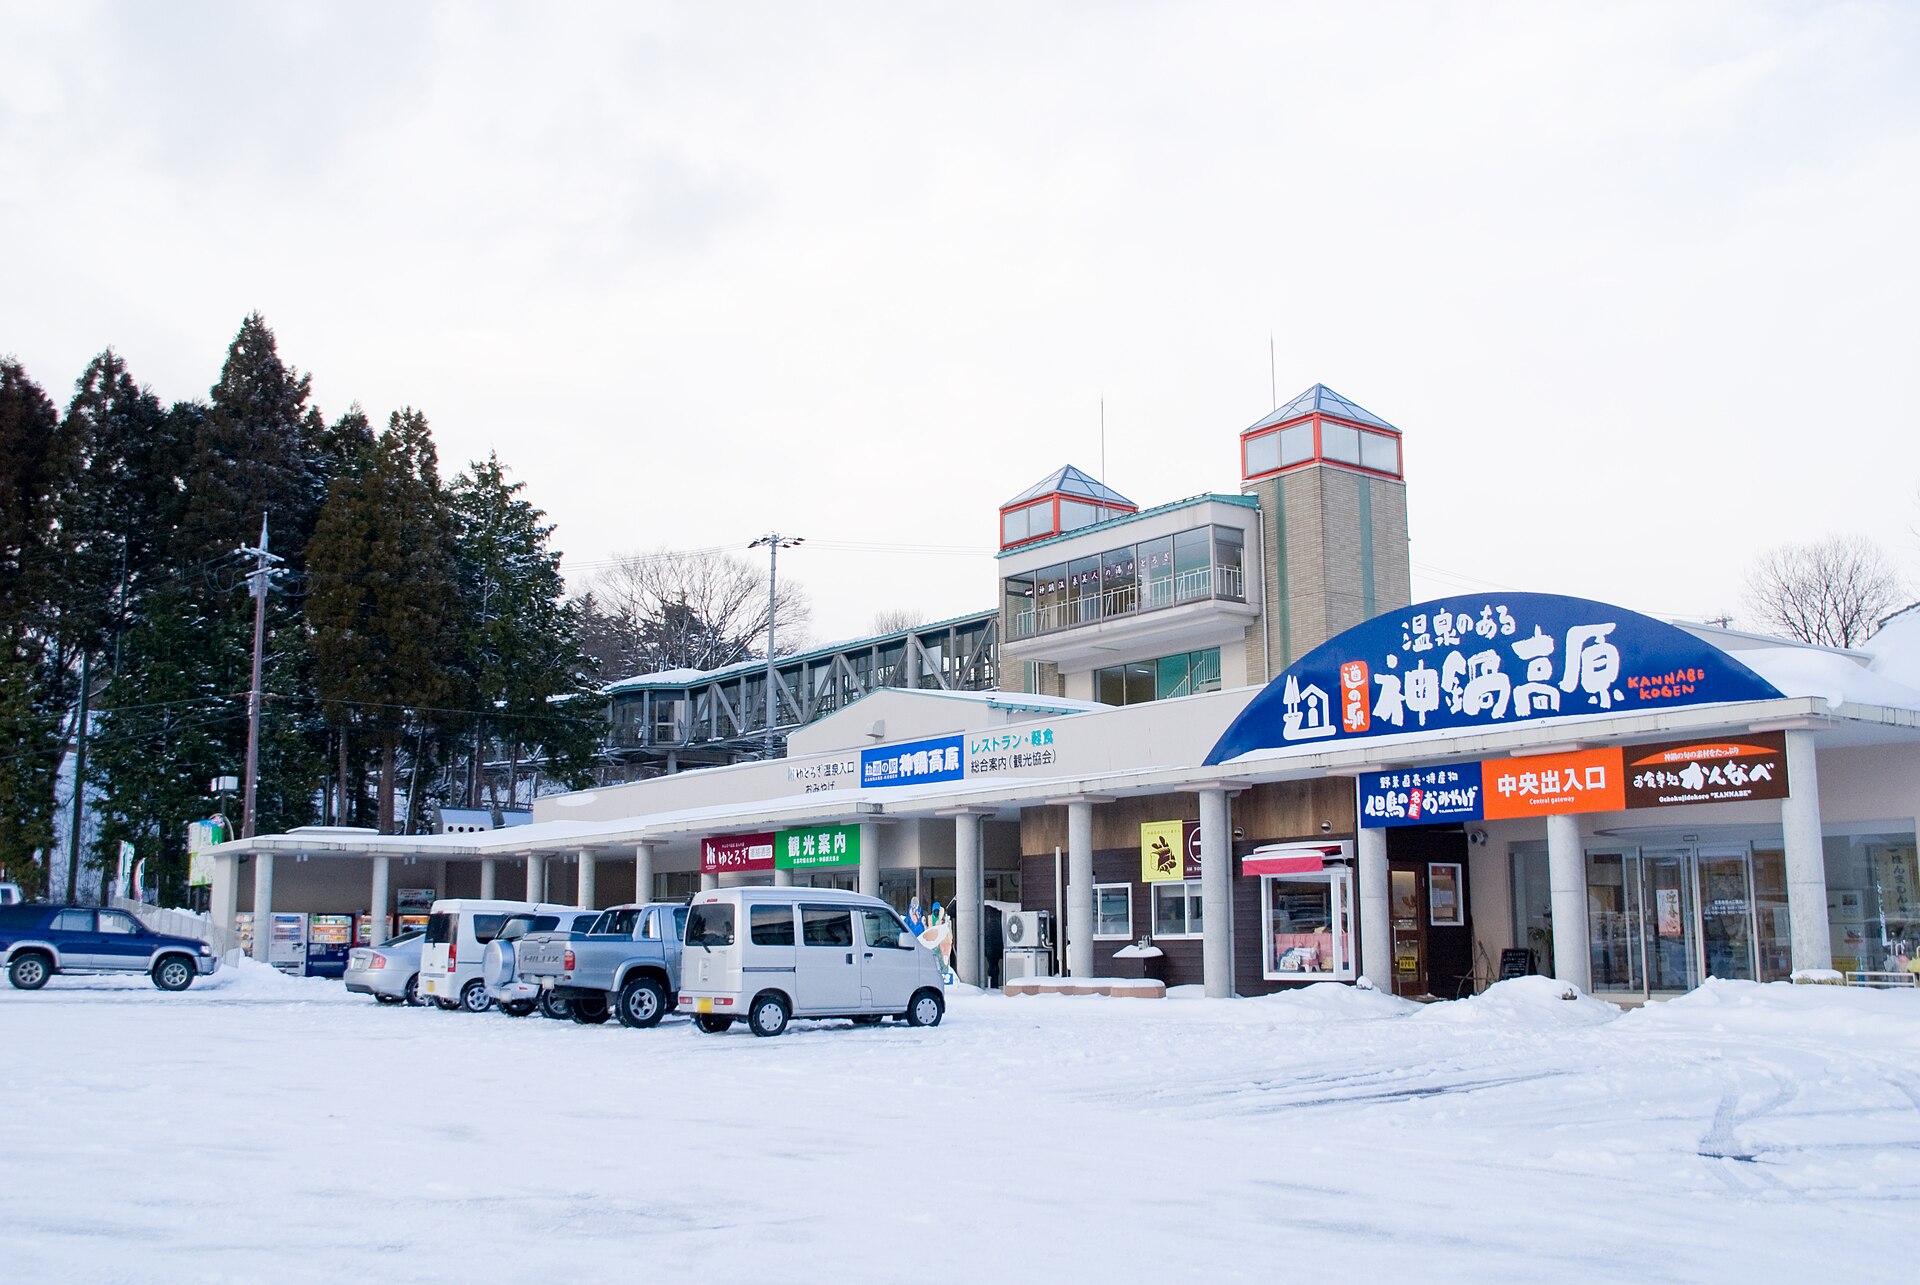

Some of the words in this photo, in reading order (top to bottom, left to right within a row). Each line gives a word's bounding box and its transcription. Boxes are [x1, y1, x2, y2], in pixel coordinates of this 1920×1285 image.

[1402, 605, 1516, 652] 温泉のある
[1372, 622, 1625, 727] 神鍋高原
[1627, 668, 1705, 689] KANNABE
[1343, 664, 1366, 730] 道の駅
[1640, 685, 1694, 700] KOGEN
[971, 728, 1053, 755] レストラン・軽食
[899, 746, 960, 778] 神鍋高原
[1633, 770, 1680, 789] お食事処
[1679, 760, 1775, 790] かんなべ
[1380, 771, 1459, 789] 野菜直売・特産物
[1497, 766, 1606, 797] 中央出入口
[1529, 797, 1550, 805] Central
[1550, 796, 1574, 805] gateway
[718, 847, 748, 866] ゆとろぎ
[788, 831, 846, 857] 観光案内
[523, 954, 560, 963] HILUX
